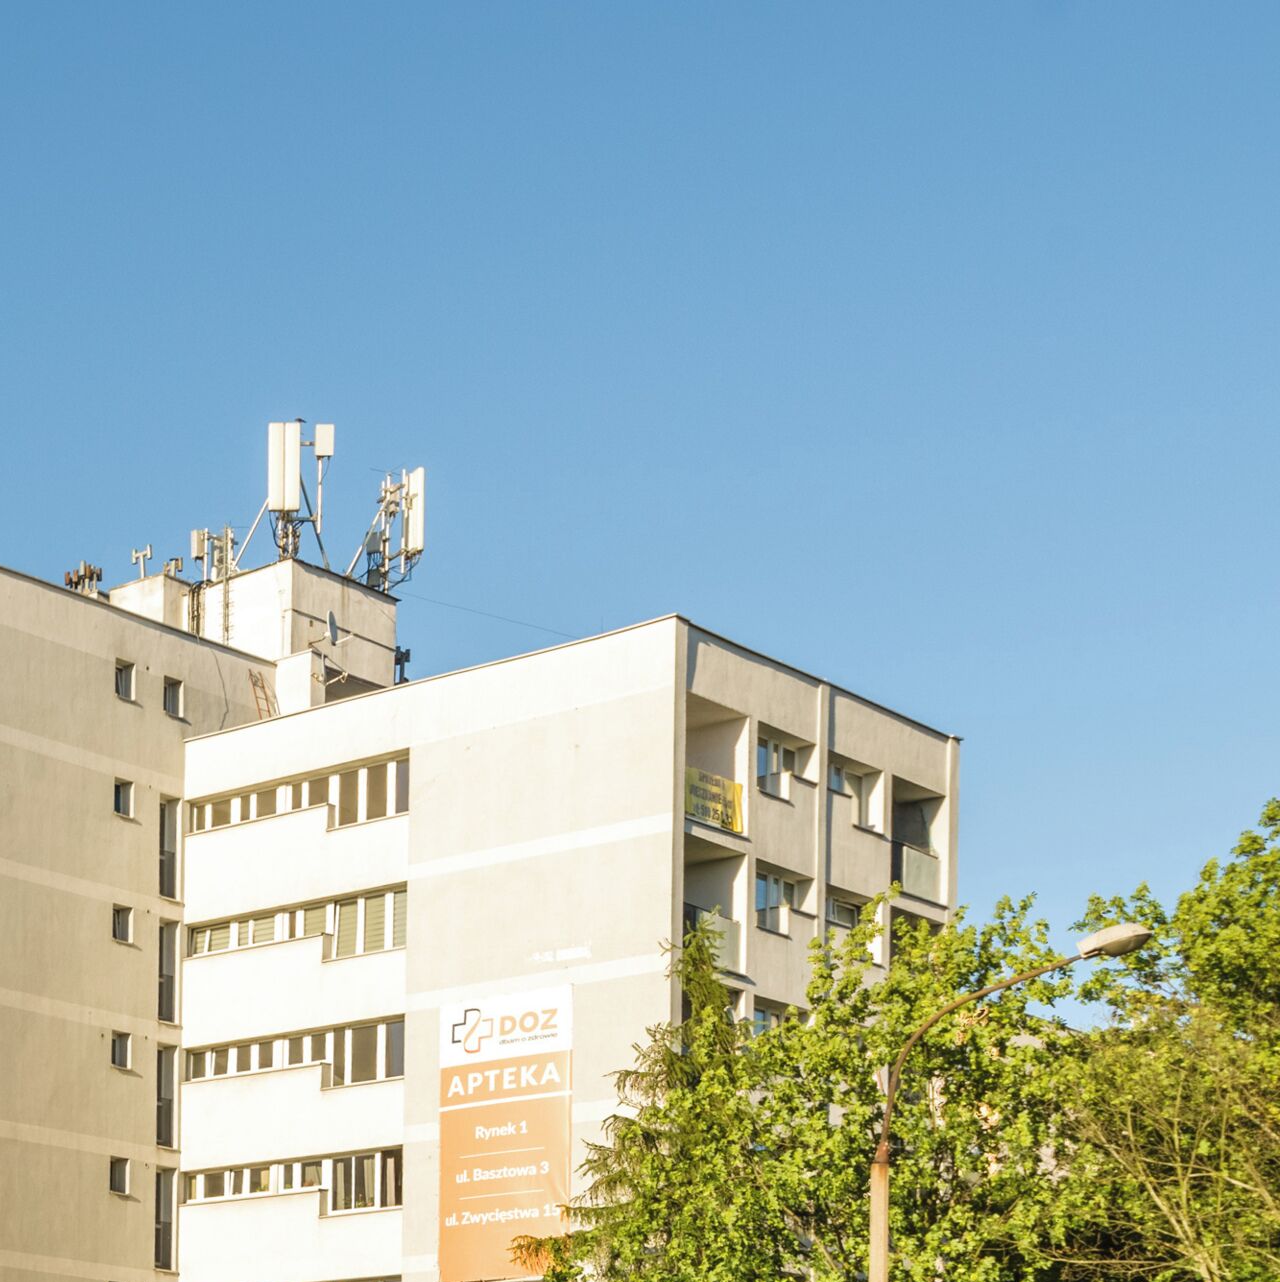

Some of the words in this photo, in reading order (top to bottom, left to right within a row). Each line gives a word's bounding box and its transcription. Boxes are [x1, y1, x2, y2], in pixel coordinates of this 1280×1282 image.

[499, 1008, 558, 1036] DOZ
[447, 1061, 561, 1098] APTEKA
[475, 1122, 516, 1140] Rynek
[519, 1120, 528, 1134] 1
[455, 1169, 470, 1184] ul.
[473, 1164, 537, 1182] Basztowa
[540, 1161, 550, 1174] 3
[445, 1213, 459, 1227] ul.
[461, 1207, 539, 1225] Zwycięstwa
[543, 1203, 561, 1217] 15
